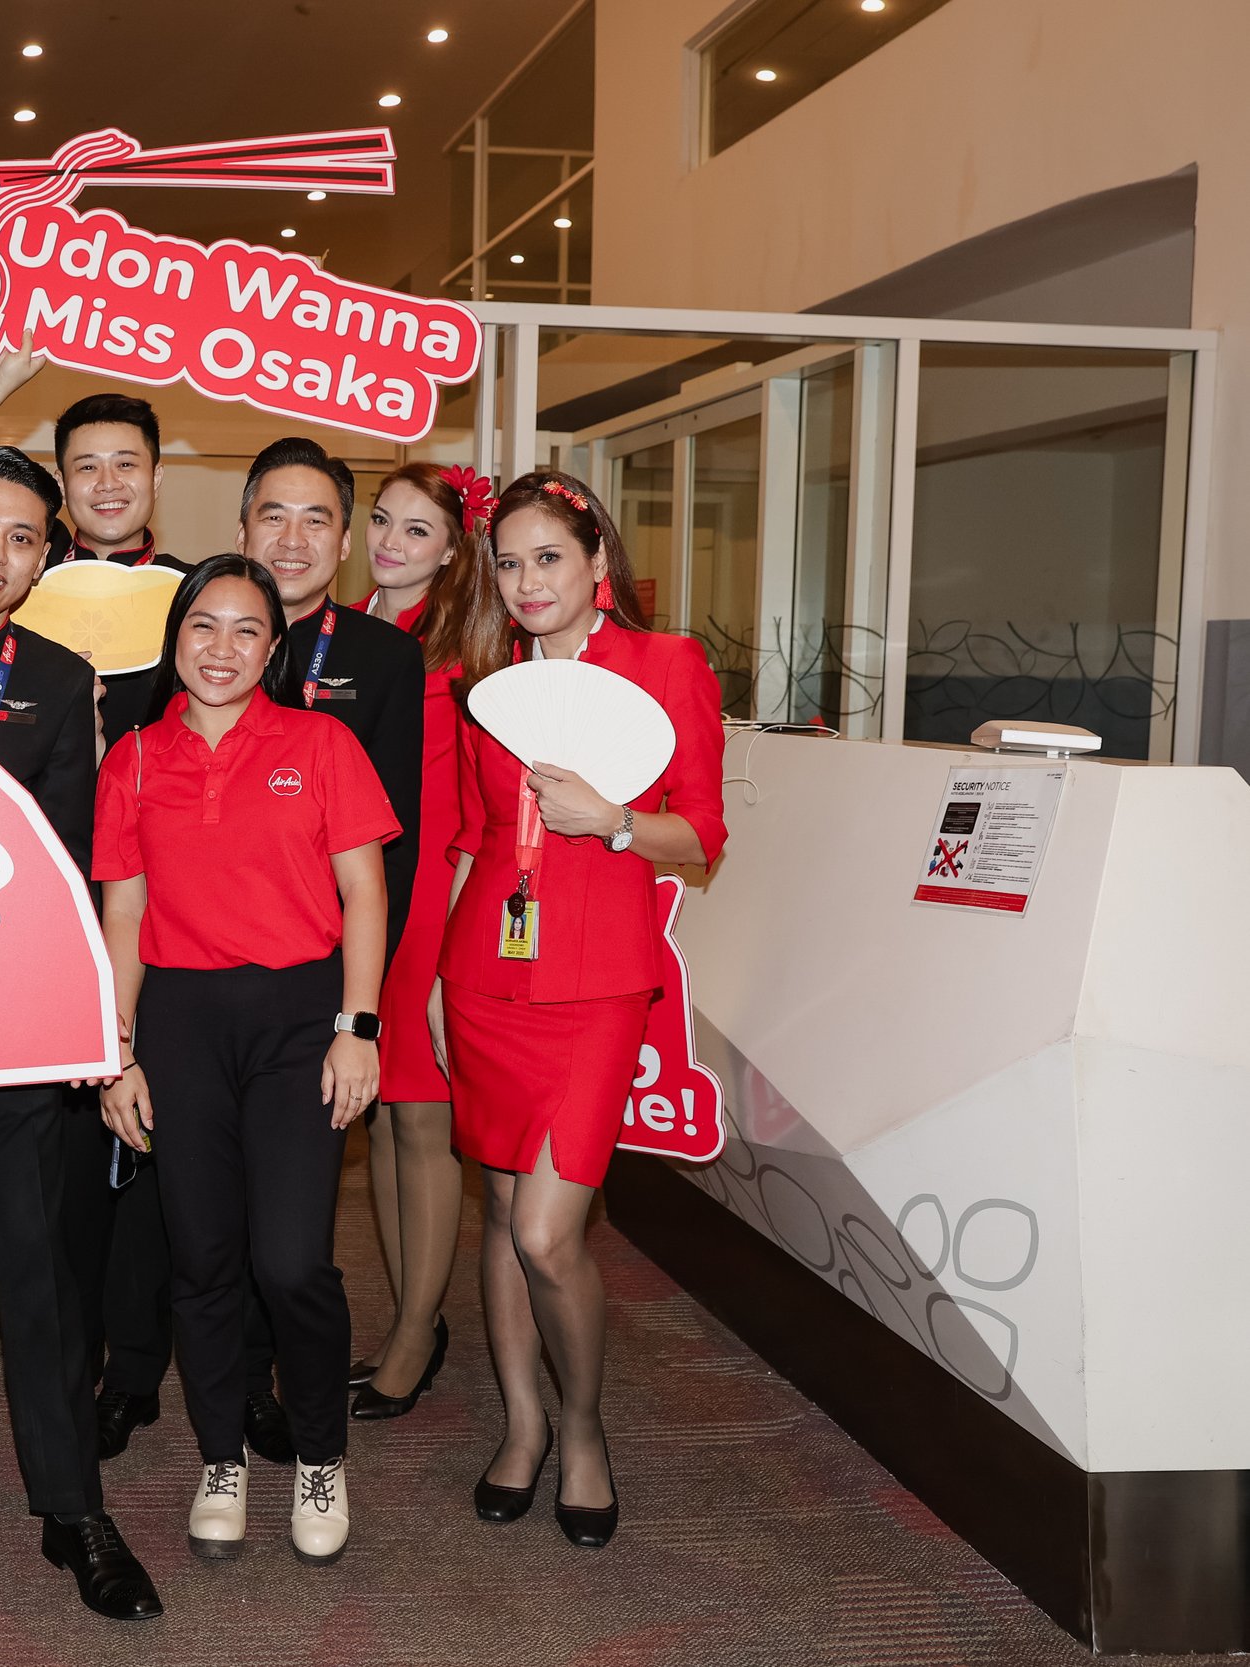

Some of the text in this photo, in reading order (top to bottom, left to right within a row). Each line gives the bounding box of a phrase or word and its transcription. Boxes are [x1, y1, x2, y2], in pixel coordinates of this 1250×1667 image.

[8, 215, 461, 362] Udon Wanna
[23, 286, 416, 422] Miss Osaka
[952, 782, 1012, 791] SECURITY NOTICE
